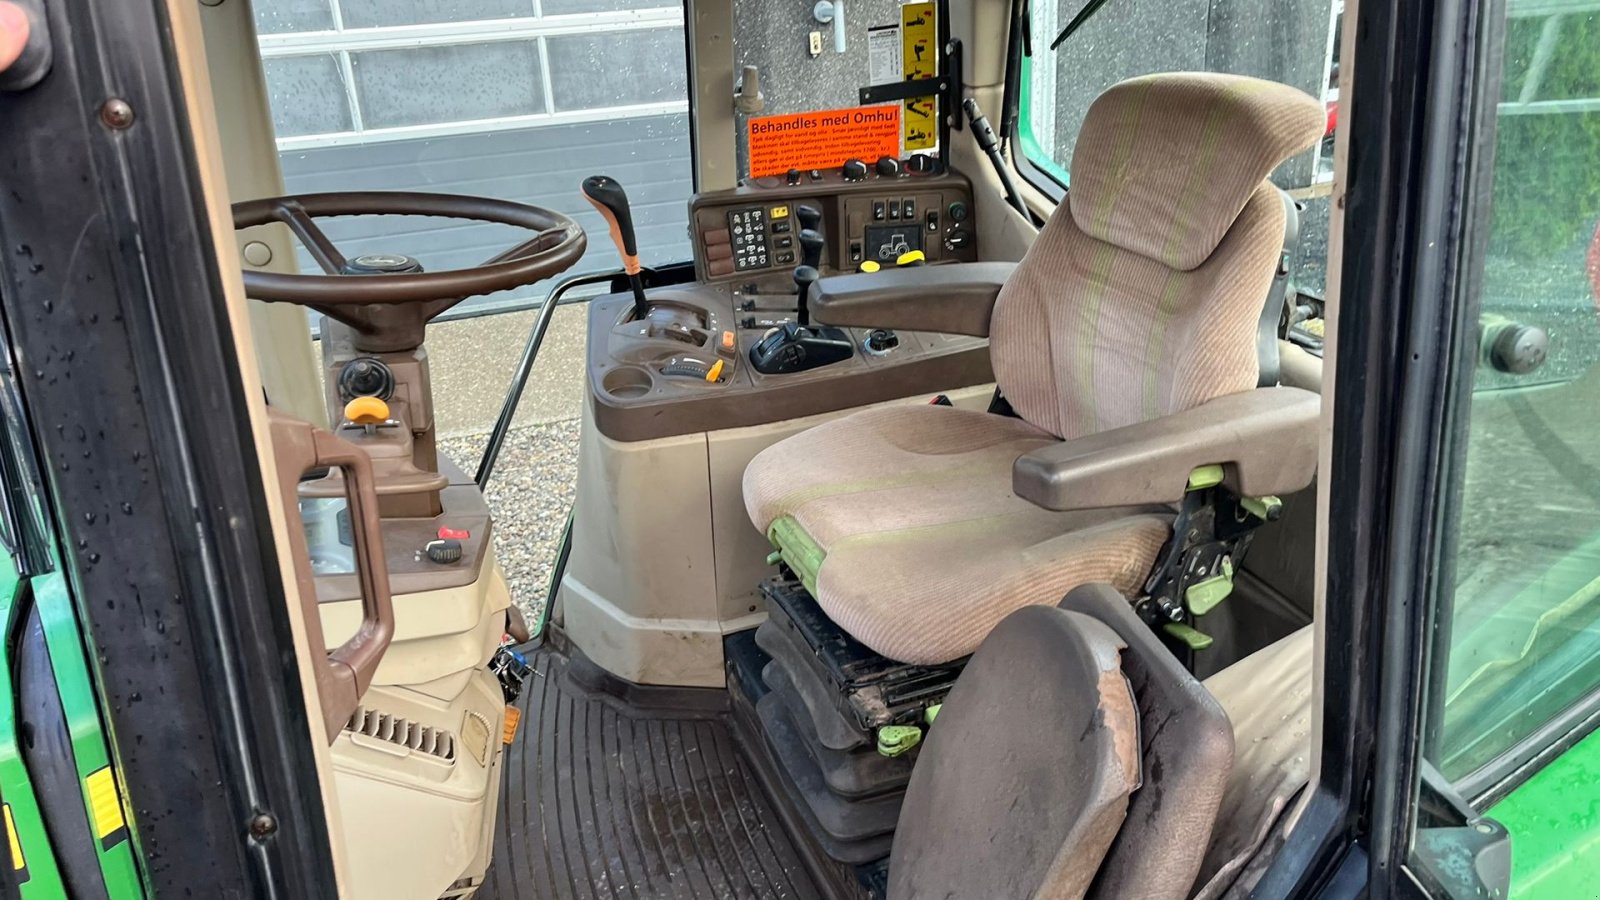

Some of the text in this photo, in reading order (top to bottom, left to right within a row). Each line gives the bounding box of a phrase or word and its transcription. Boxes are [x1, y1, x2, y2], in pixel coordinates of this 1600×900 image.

[752, 109, 898, 134] Behandles med Omhu!
